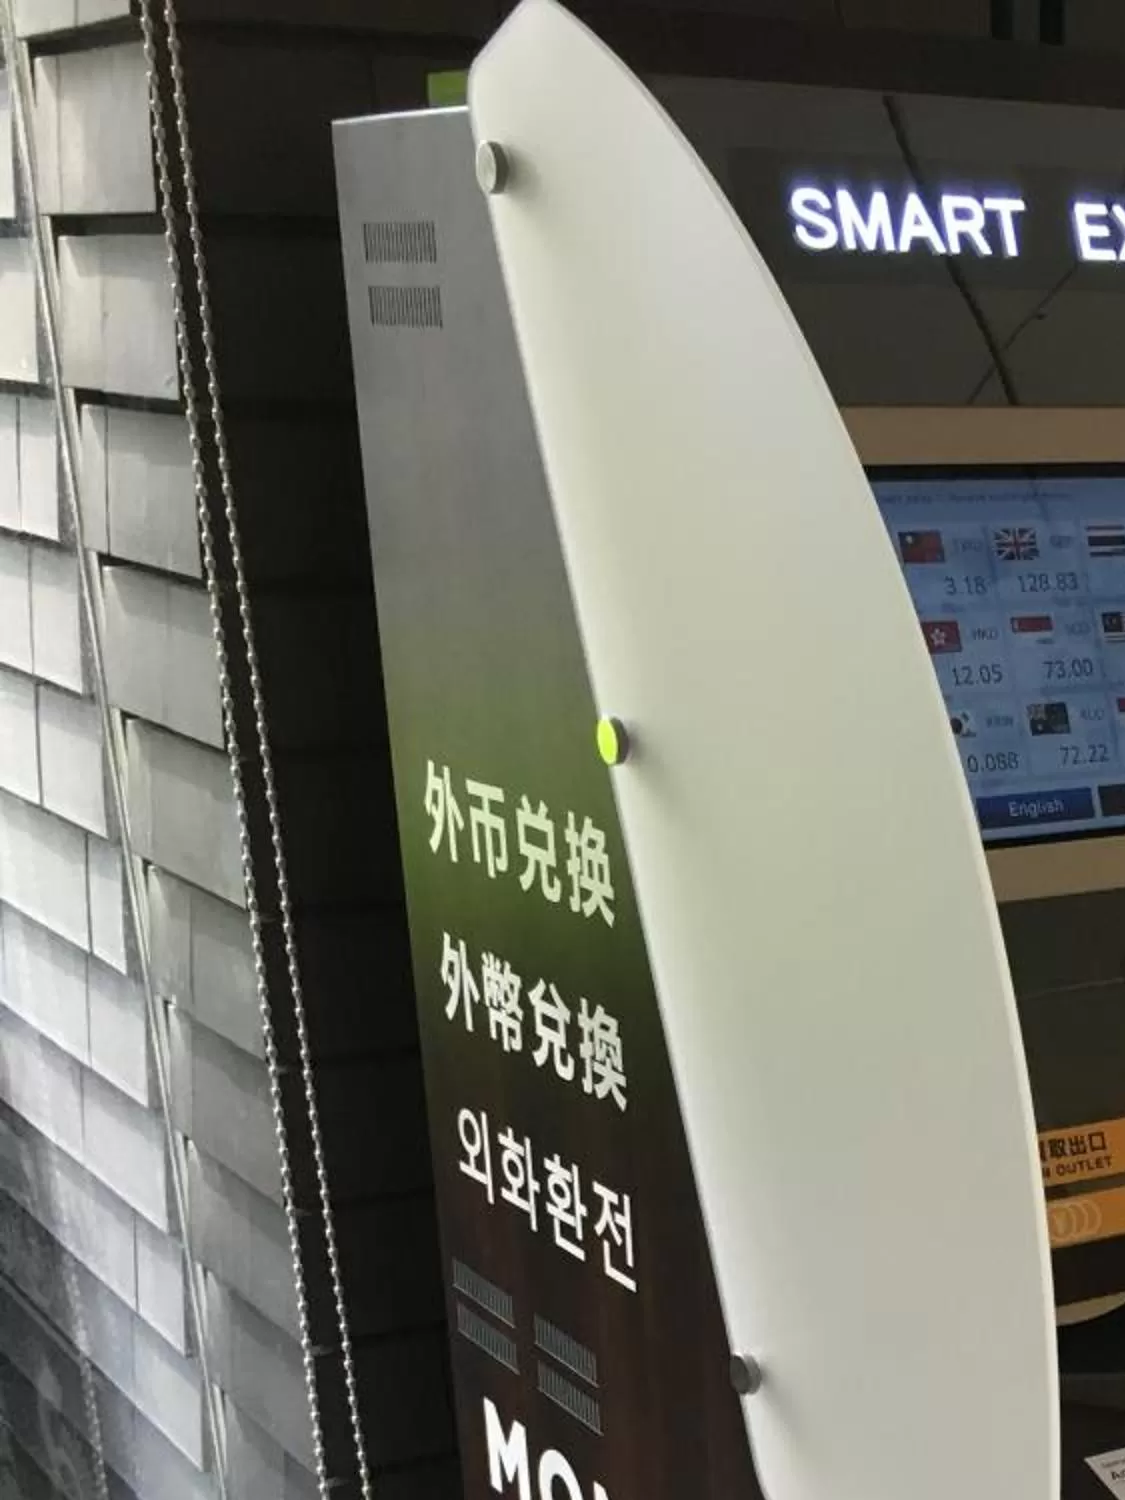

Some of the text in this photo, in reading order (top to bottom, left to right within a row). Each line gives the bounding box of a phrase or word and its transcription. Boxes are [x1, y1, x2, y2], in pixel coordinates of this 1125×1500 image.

[789, 186, 1025, 258] SMART
[944, 575, 987, 595] 3.18
[952, 664, 1003, 687] 12.05
[1042, 658, 1094, 680] 73.00
[1059, 743, 1110, 766] 72.22
[1008, 799, 1065, 818] English
[422, 760, 616, 928] 外币兑换
[440, 931, 628, 1110] 外幣兌換
[1040, 1132, 1107, 1161] 取出口
[1055, 1155, 1112, 1177] OUTLET
[456, 1106, 638, 1293] 외화환전
